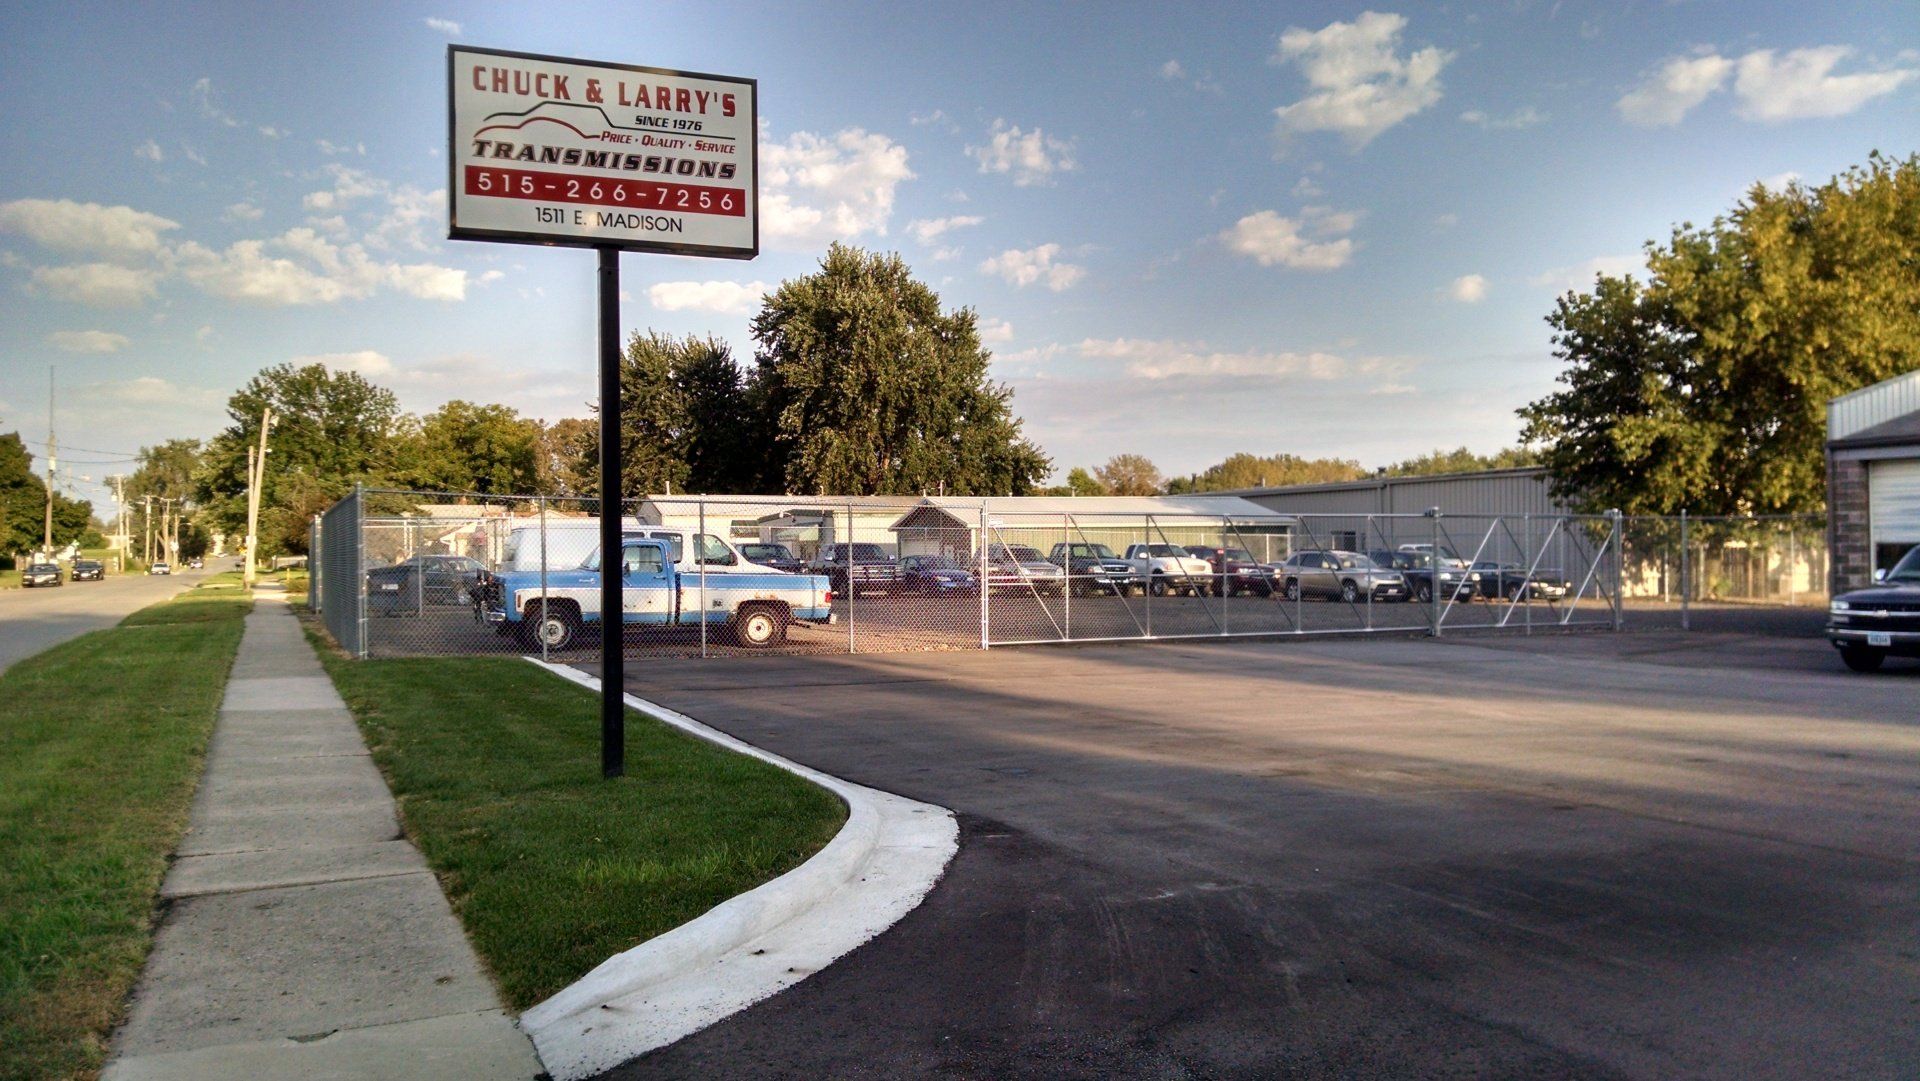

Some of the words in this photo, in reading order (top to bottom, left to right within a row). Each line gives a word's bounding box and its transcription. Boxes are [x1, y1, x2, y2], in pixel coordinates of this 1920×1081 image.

[473, 65, 571, 100] CHUCK
[586, 78, 603, 103] &
[618, 82, 736, 117] LARRY'S
[635, 115, 669, 128] SINCE
[672, 120, 703, 131] 1976
[601, 131, 632, 144] PRICE
[641, 134, 686, 149] QUALITY
[694, 140, 736, 154] SERVICE
[472, 139, 737, 180] TRANSMISSIONS
[478, 172, 733, 210] 515-266-7256
[536, 207, 564, 224] 1511
[574, 210, 587, 225] E.
[597, 212, 682, 232] MADISON
